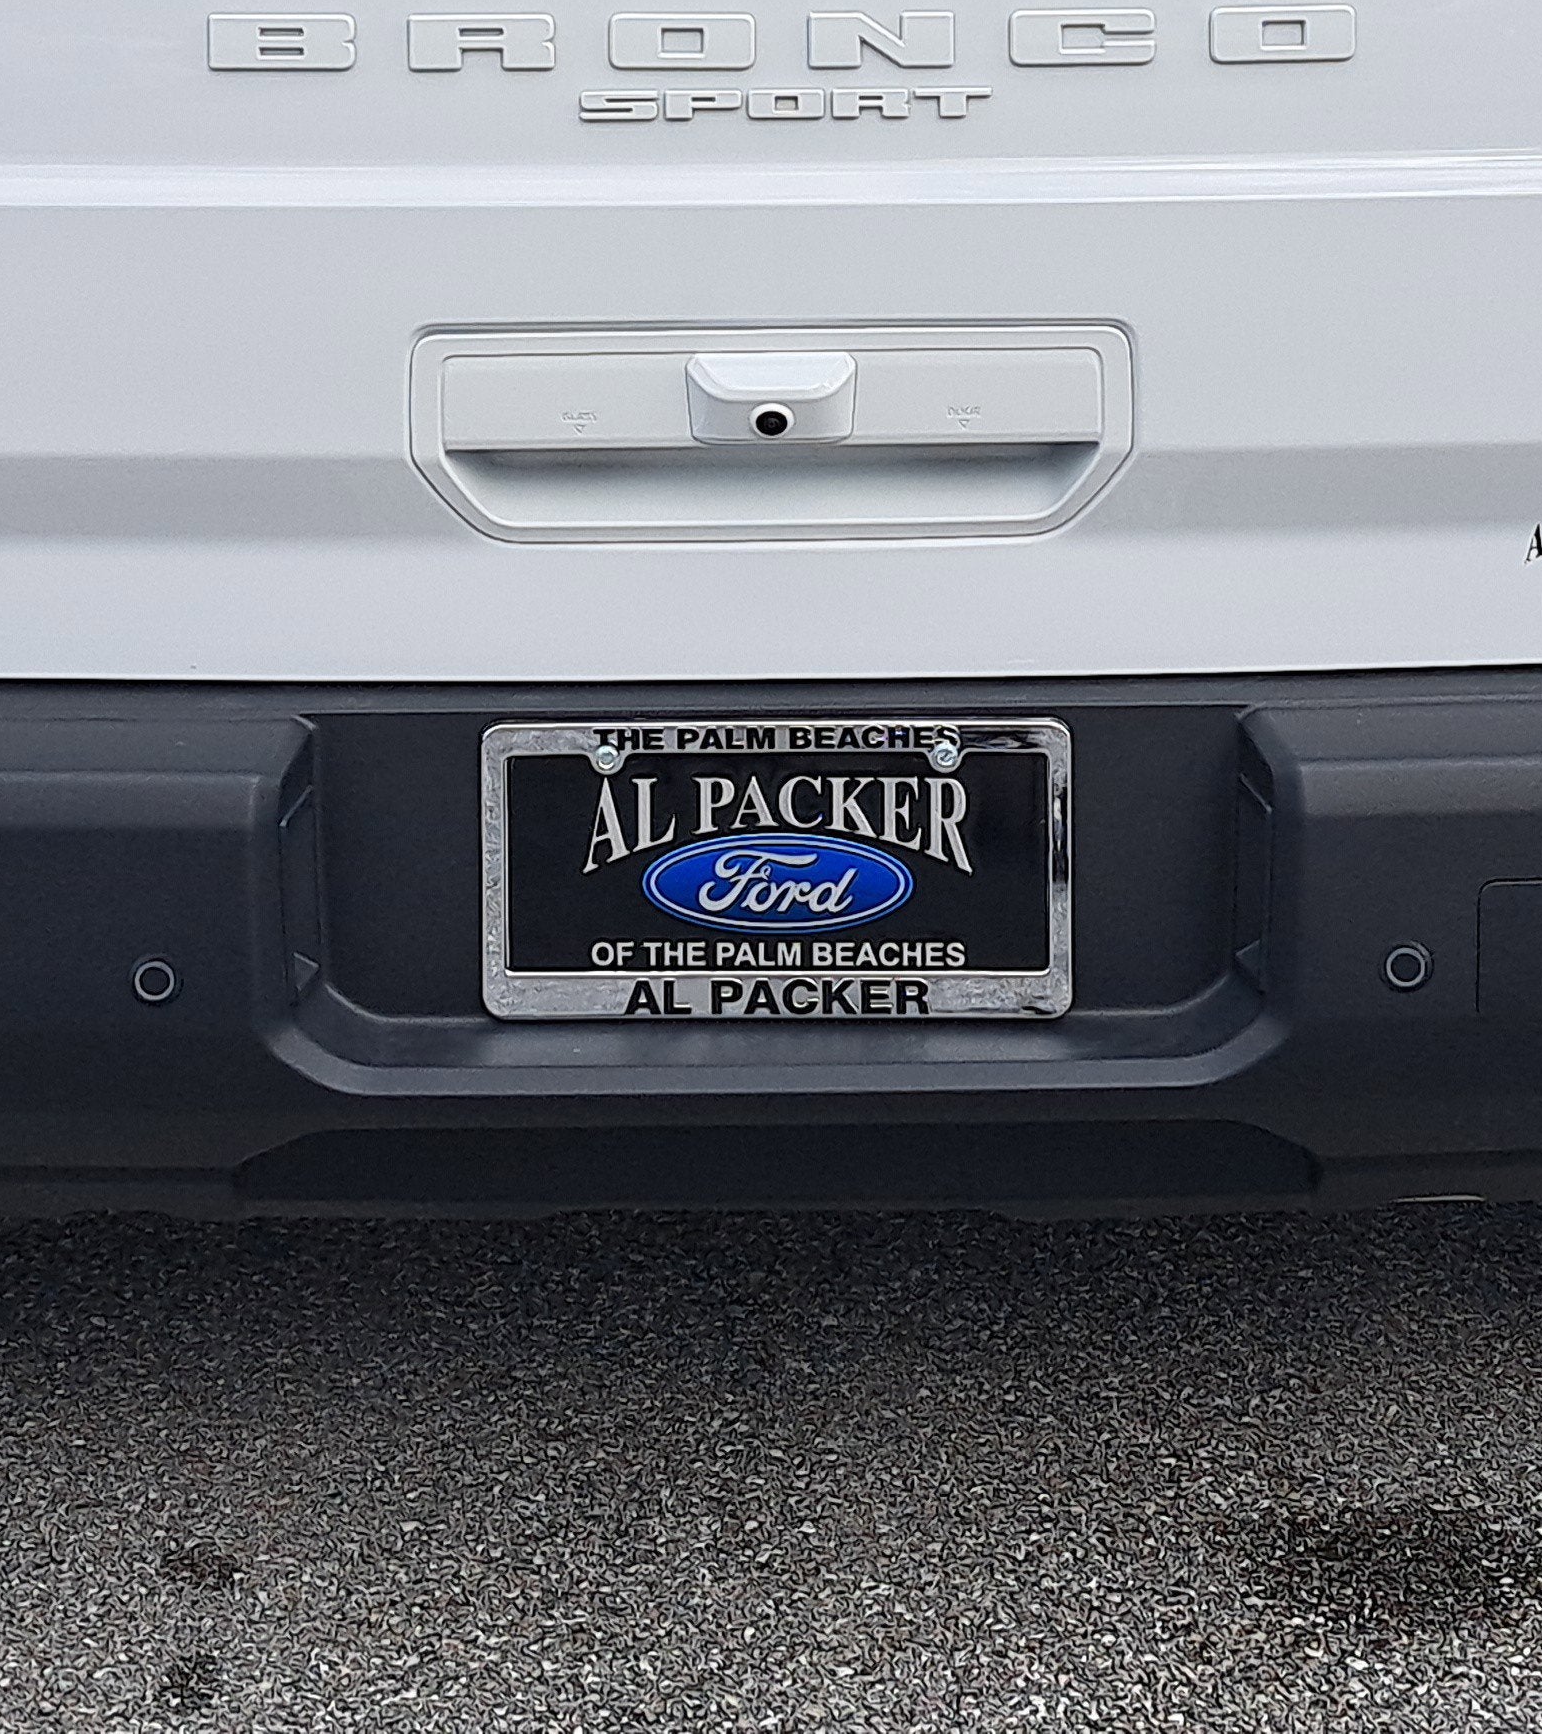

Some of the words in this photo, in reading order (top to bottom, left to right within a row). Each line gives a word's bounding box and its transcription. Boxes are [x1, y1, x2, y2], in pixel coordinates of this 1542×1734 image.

[207, 4, 1357, 72] BRONCO
[578, 86, 994, 122] SPORT
[592, 728, 665, 751] THE
[676, 727, 776, 750] PALM
[788, 725, 960, 750] BEACHES
[582, 776, 677, 874] AL
[691, 775, 973, 876] PACKER
[698, 848, 858, 913] Ford
[591, 941, 635, 967] OF
[643, 941, 707, 967] THE
[716, 941, 802, 967] PALM
[812, 941, 966, 967] BEACHES
[624, 979, 692, 1015] AL
[710, 978, 930, 1015] PACKER
